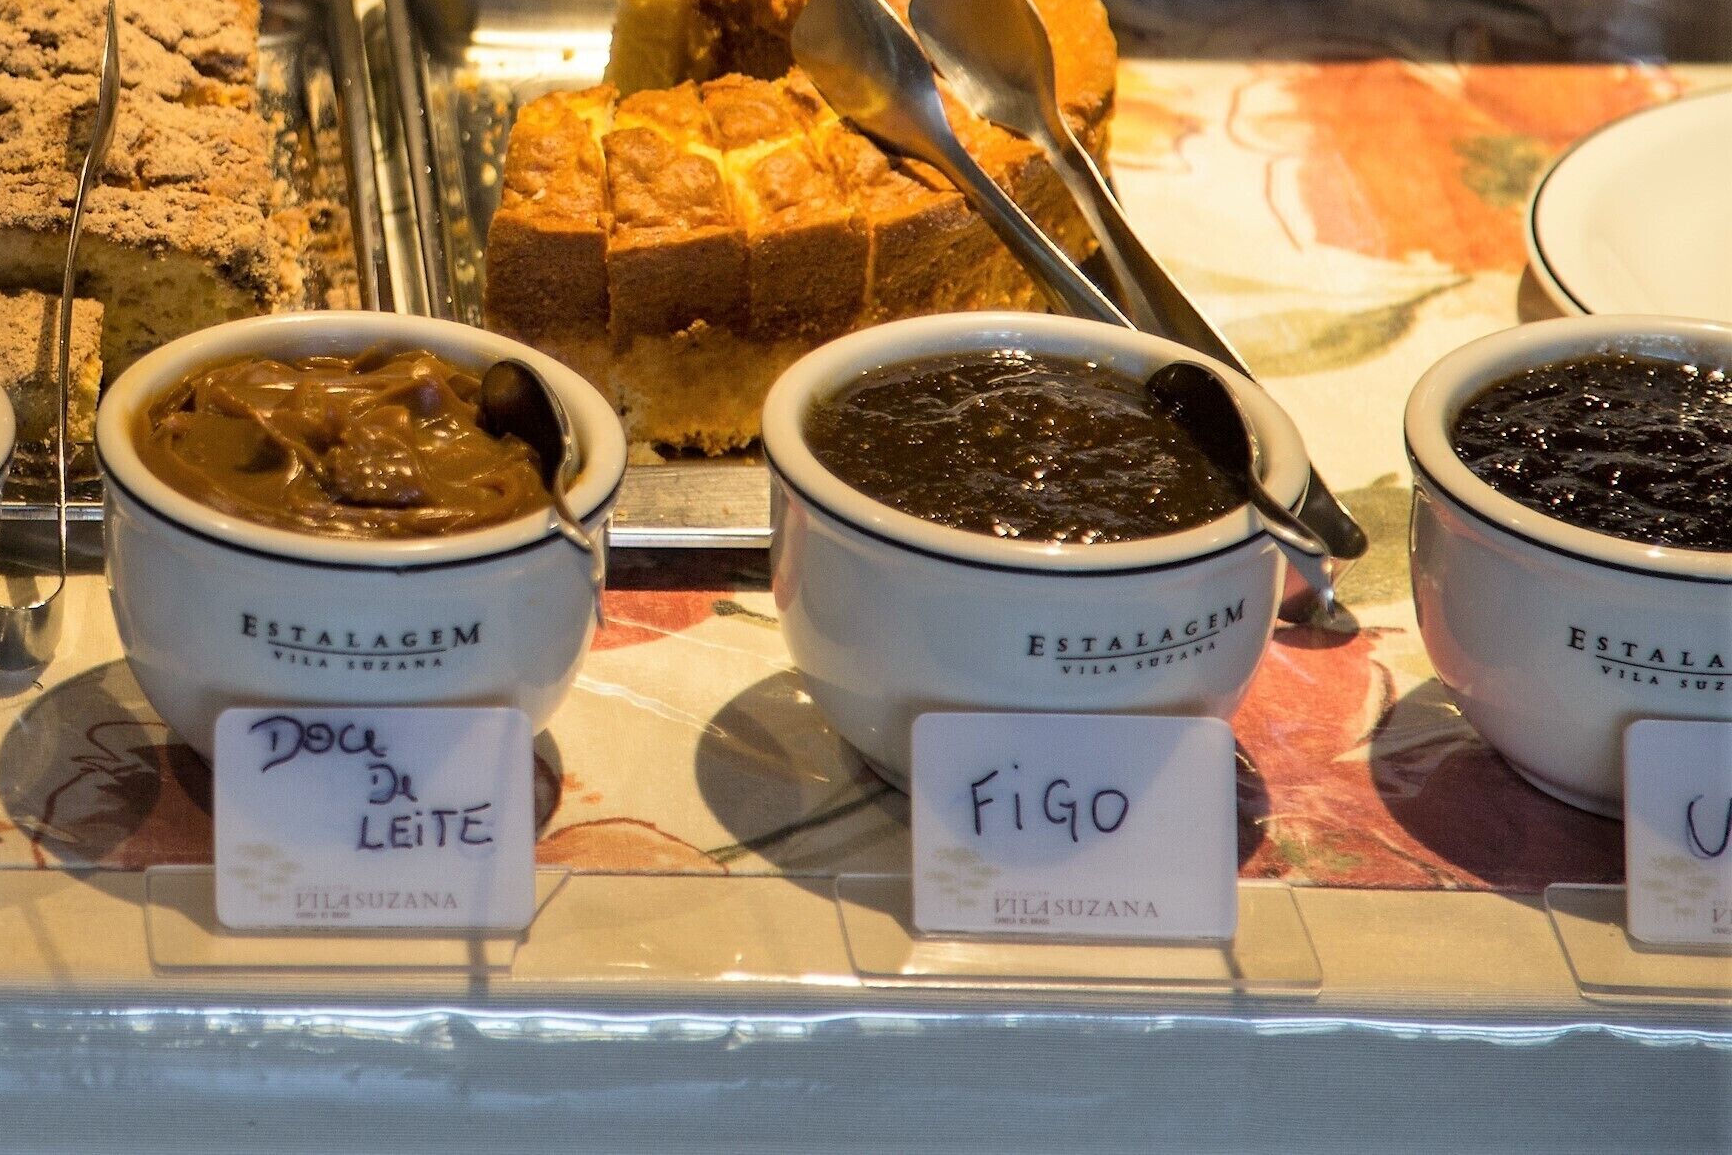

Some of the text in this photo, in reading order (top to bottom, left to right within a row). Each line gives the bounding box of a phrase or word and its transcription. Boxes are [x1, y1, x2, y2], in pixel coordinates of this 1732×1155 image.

[241, 612, 481, 648] ESTALAGEM
[1026, 598, 1245, 657] ESTALAGEM
[273, 650, 328, 668] VILA
[1062, 642, 1216, 675] VILA SUZANA
[1601, 664, 1659, 685] VILA
